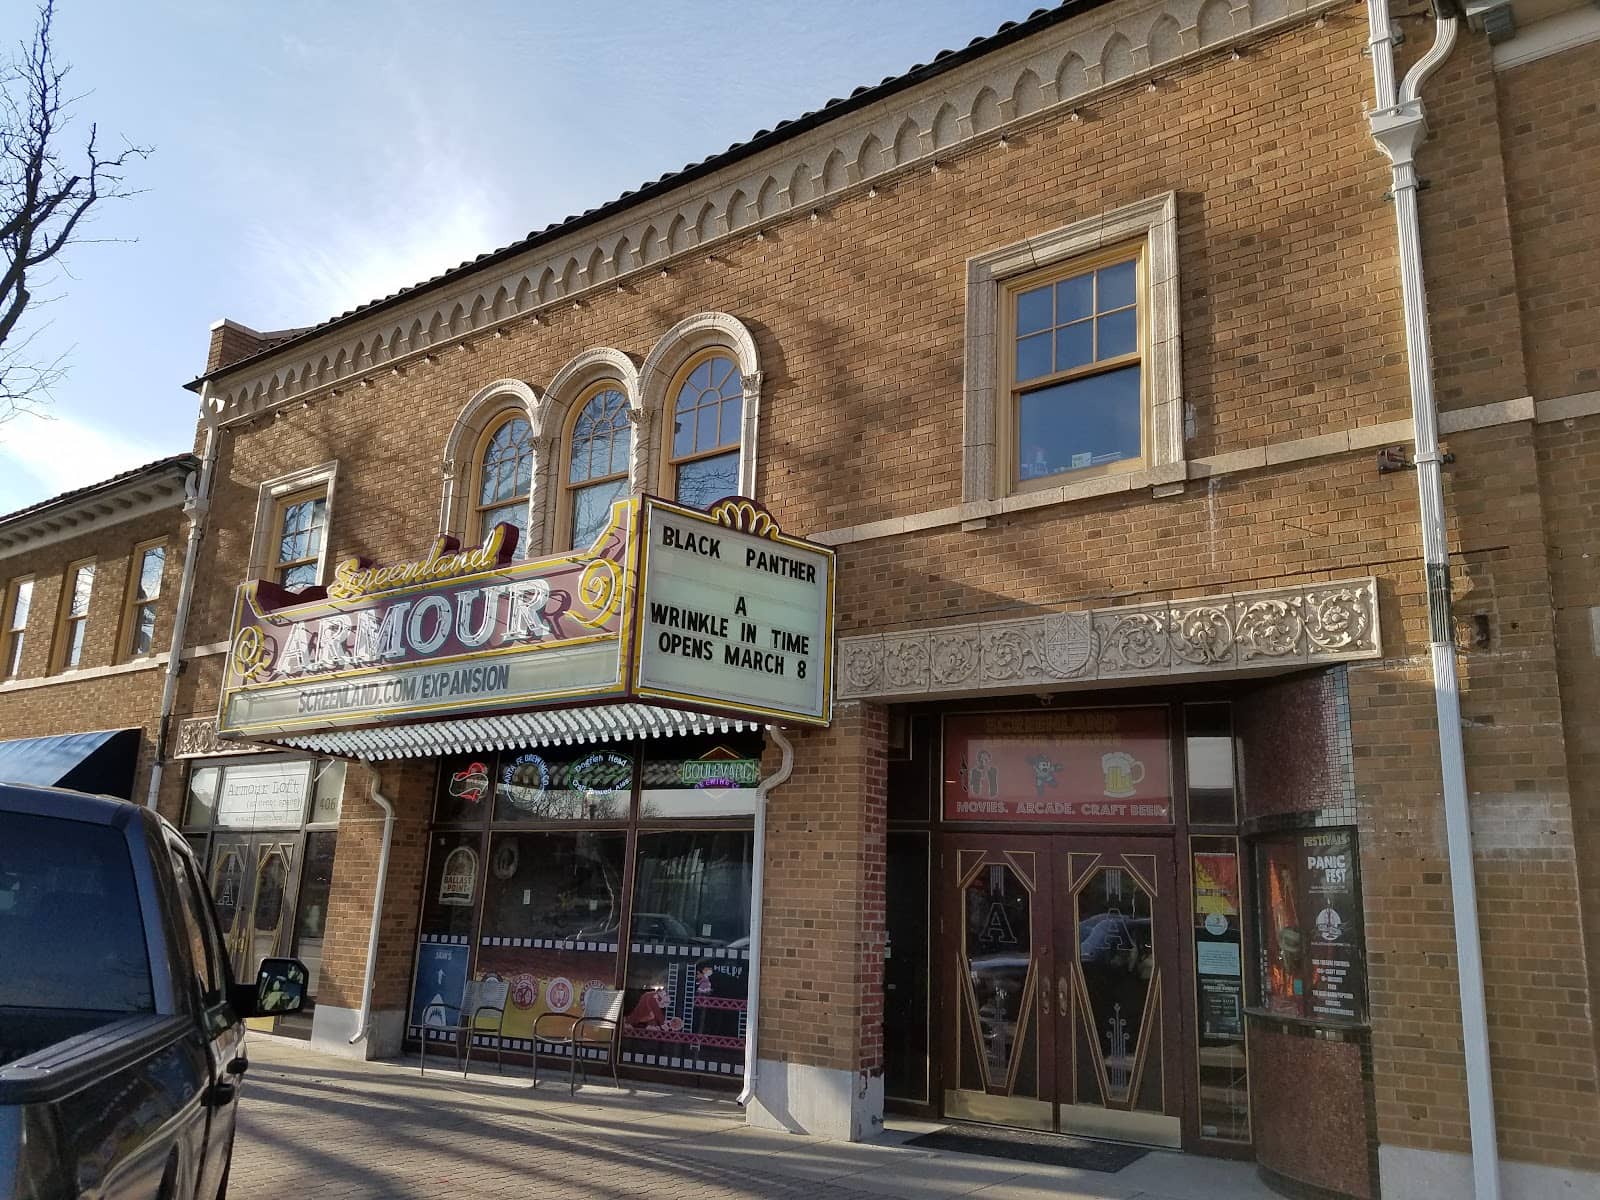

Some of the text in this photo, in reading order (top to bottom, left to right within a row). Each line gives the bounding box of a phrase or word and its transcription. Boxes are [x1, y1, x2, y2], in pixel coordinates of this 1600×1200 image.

[326, 522, 506, 599] Screenland
[662, 525, 816, 584] BLACK PANTHER
[734, 596, 747, 617] A
[276, 578, 552, 675] ARMOUR
[651, 602, 809, 655] WRINKLE IN TIME
[658, 631, 807, 679] OPENS MARCH 8
[297, 664, 511, 713] SCREENLAND.COM/EXPANSION
[574, 754, 628, 773] Dogfish Head
[684, 762, 753, 779] BOULEVARD
[228, 783, 271, 796] Armour
[319, 797, 337, 811] 406
[956, 801, 1009, 814] MOVIES.
[1016, 801, 1075, 815] ARCADE.
[1080, 803, 1127, 817] CRAFT
[1307, 855, 1346, 870] PANIC
[443, 876, 473, 885] BALLAST
[1325, 869, 1346, 883] FEST
[978, 901, 1018, 944] A
[1097, 907, 1137, 950] A
[713, 964, 744, 980] HELP!
